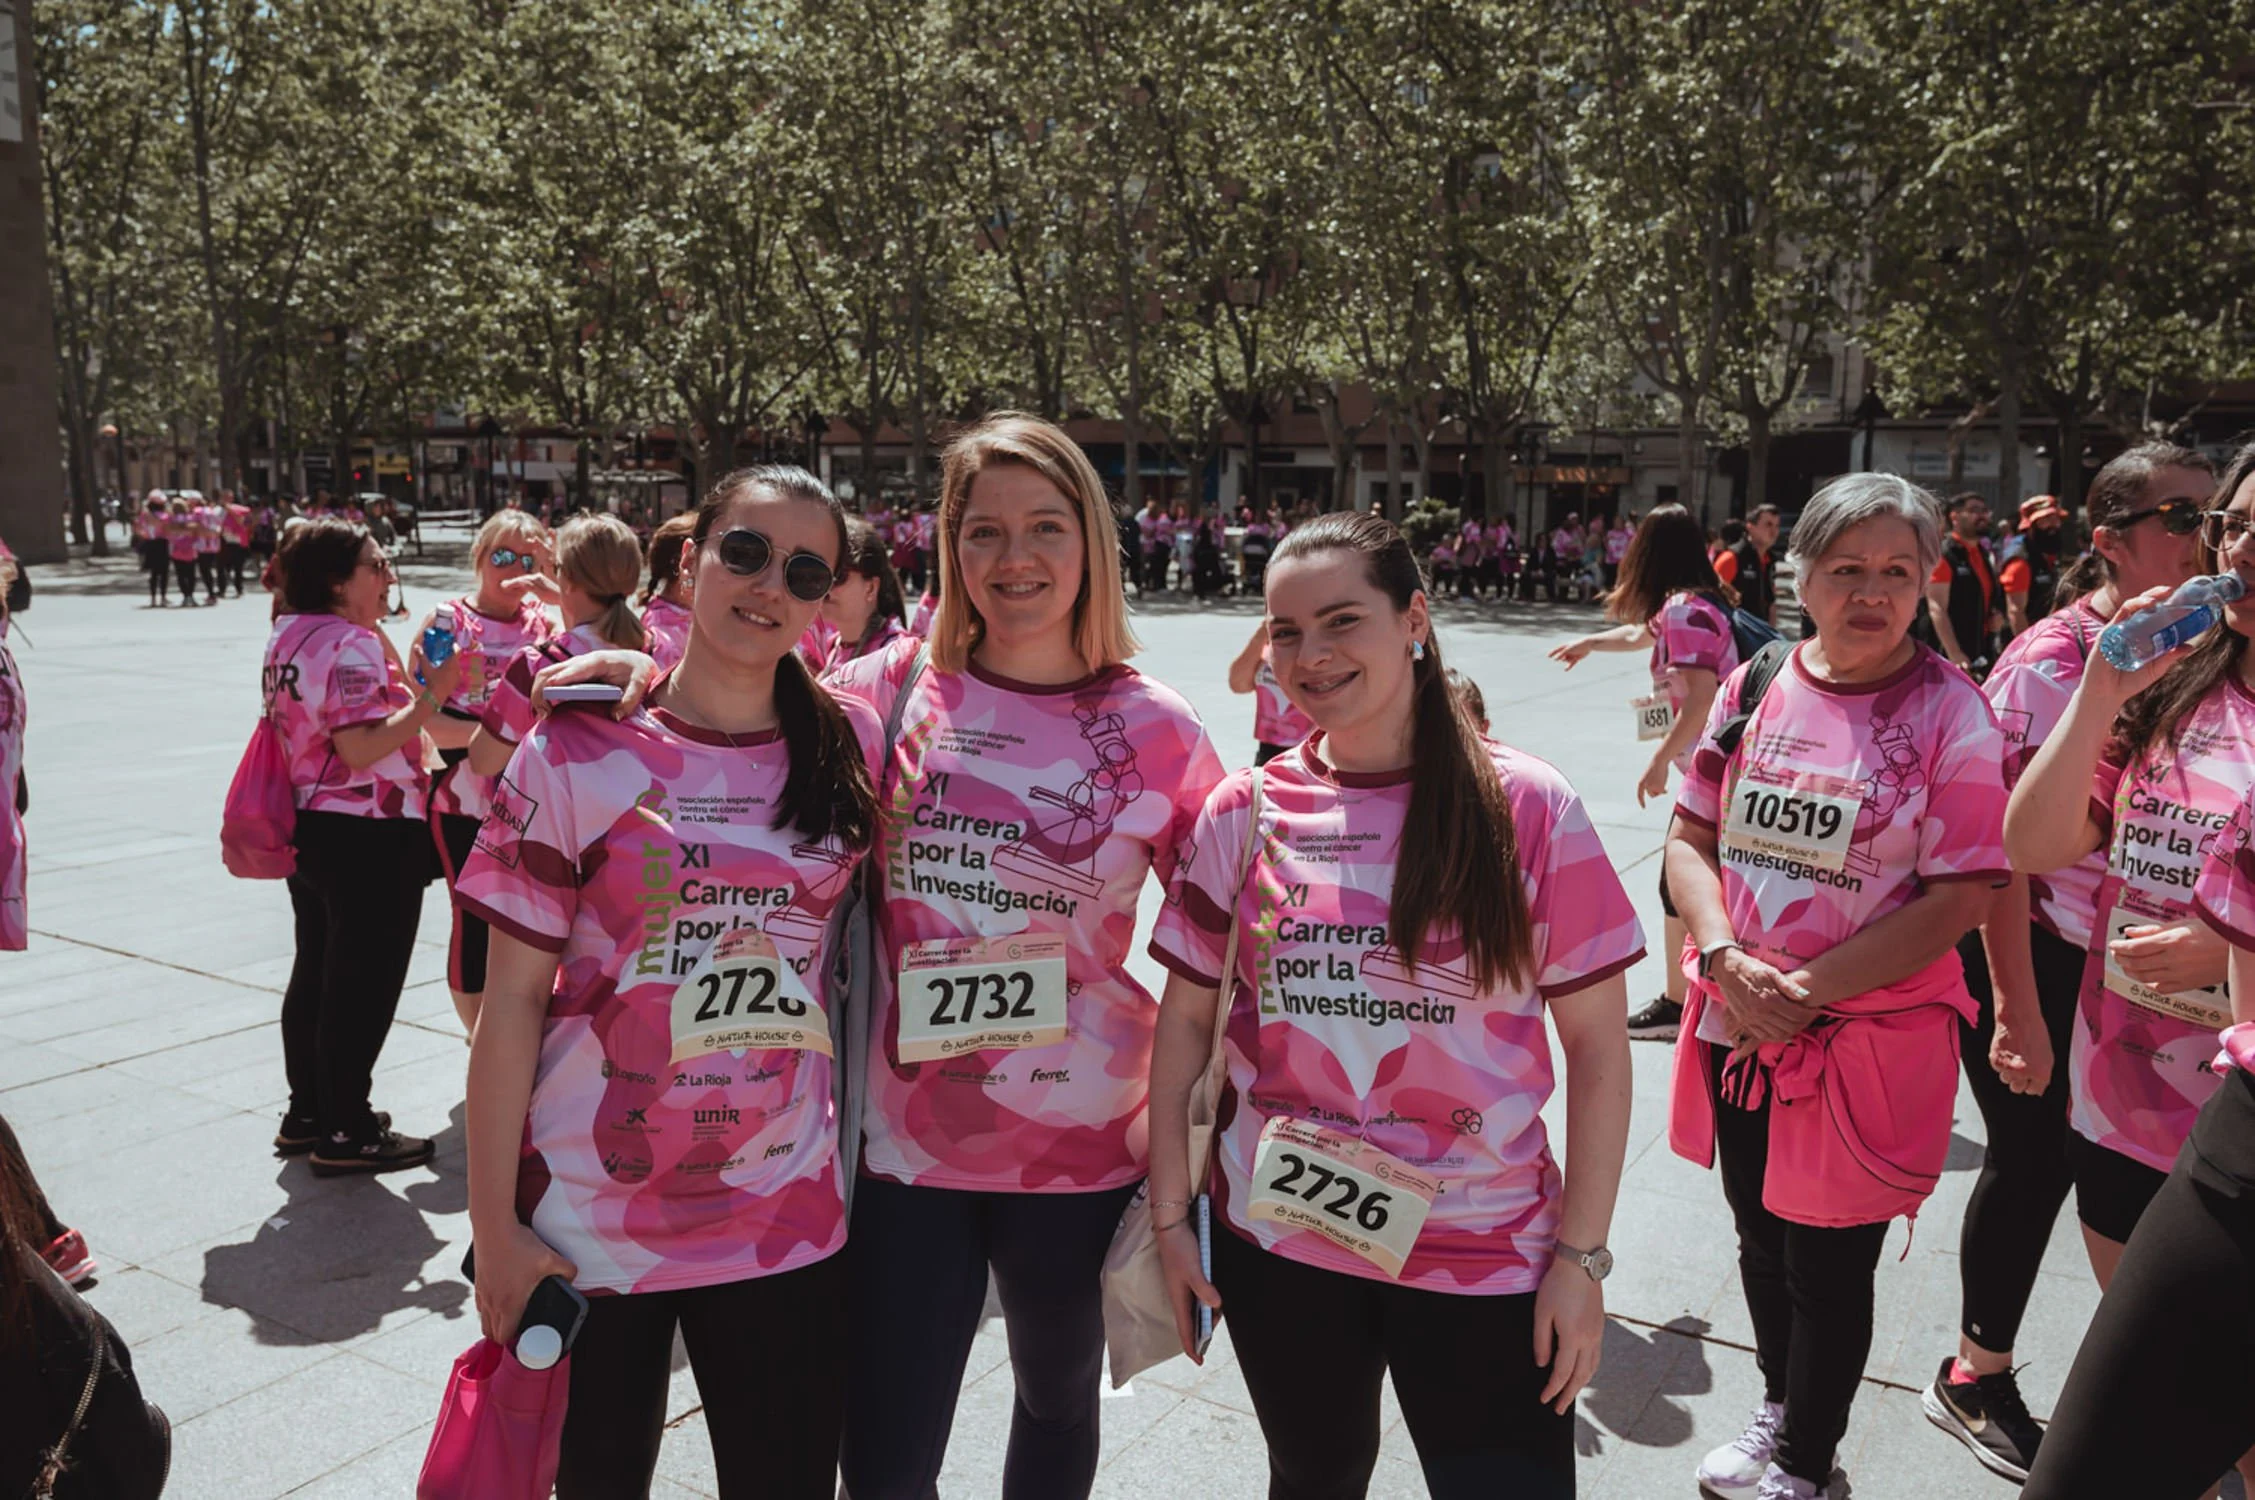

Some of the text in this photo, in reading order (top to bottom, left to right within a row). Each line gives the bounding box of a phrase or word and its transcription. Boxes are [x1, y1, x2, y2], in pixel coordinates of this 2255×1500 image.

[920, 771, 950, 797] XI
[912, 803, 1021, 842] Carrera
[1743, 790, 1842, 840] 10519
[2128, 789, 2230, 832] Carrera
[2123, 821, 2193, 856] por la
[678, 843, 710, 869] XI
[908, 839, 986, 870] por la
[1306, 854, 1317, 863] La
[1318, 853, 1339, 864] Rioja
[1727, 846, 1863, 893] Investigación
[2121, 847, 2200, 889] Investi
[679, 879, 789, 907] Carrera
[1280, 883, 1309, 908] XI
[674, 918, 726, 946] por
[1276, 916, 1386, 946] Carrera
[1275, 953, 1355, 984] por la
[927, 971, 1035, 1026] 2732
[1280, 988, 1456, 1027] Investigación
[690, 1074, 702, 1086] La
[705, 1073, 732, 1088] Rioja
[1322, 1109, 1334, 1121] La
[1269, 1153, 1393, 1232] 2726
